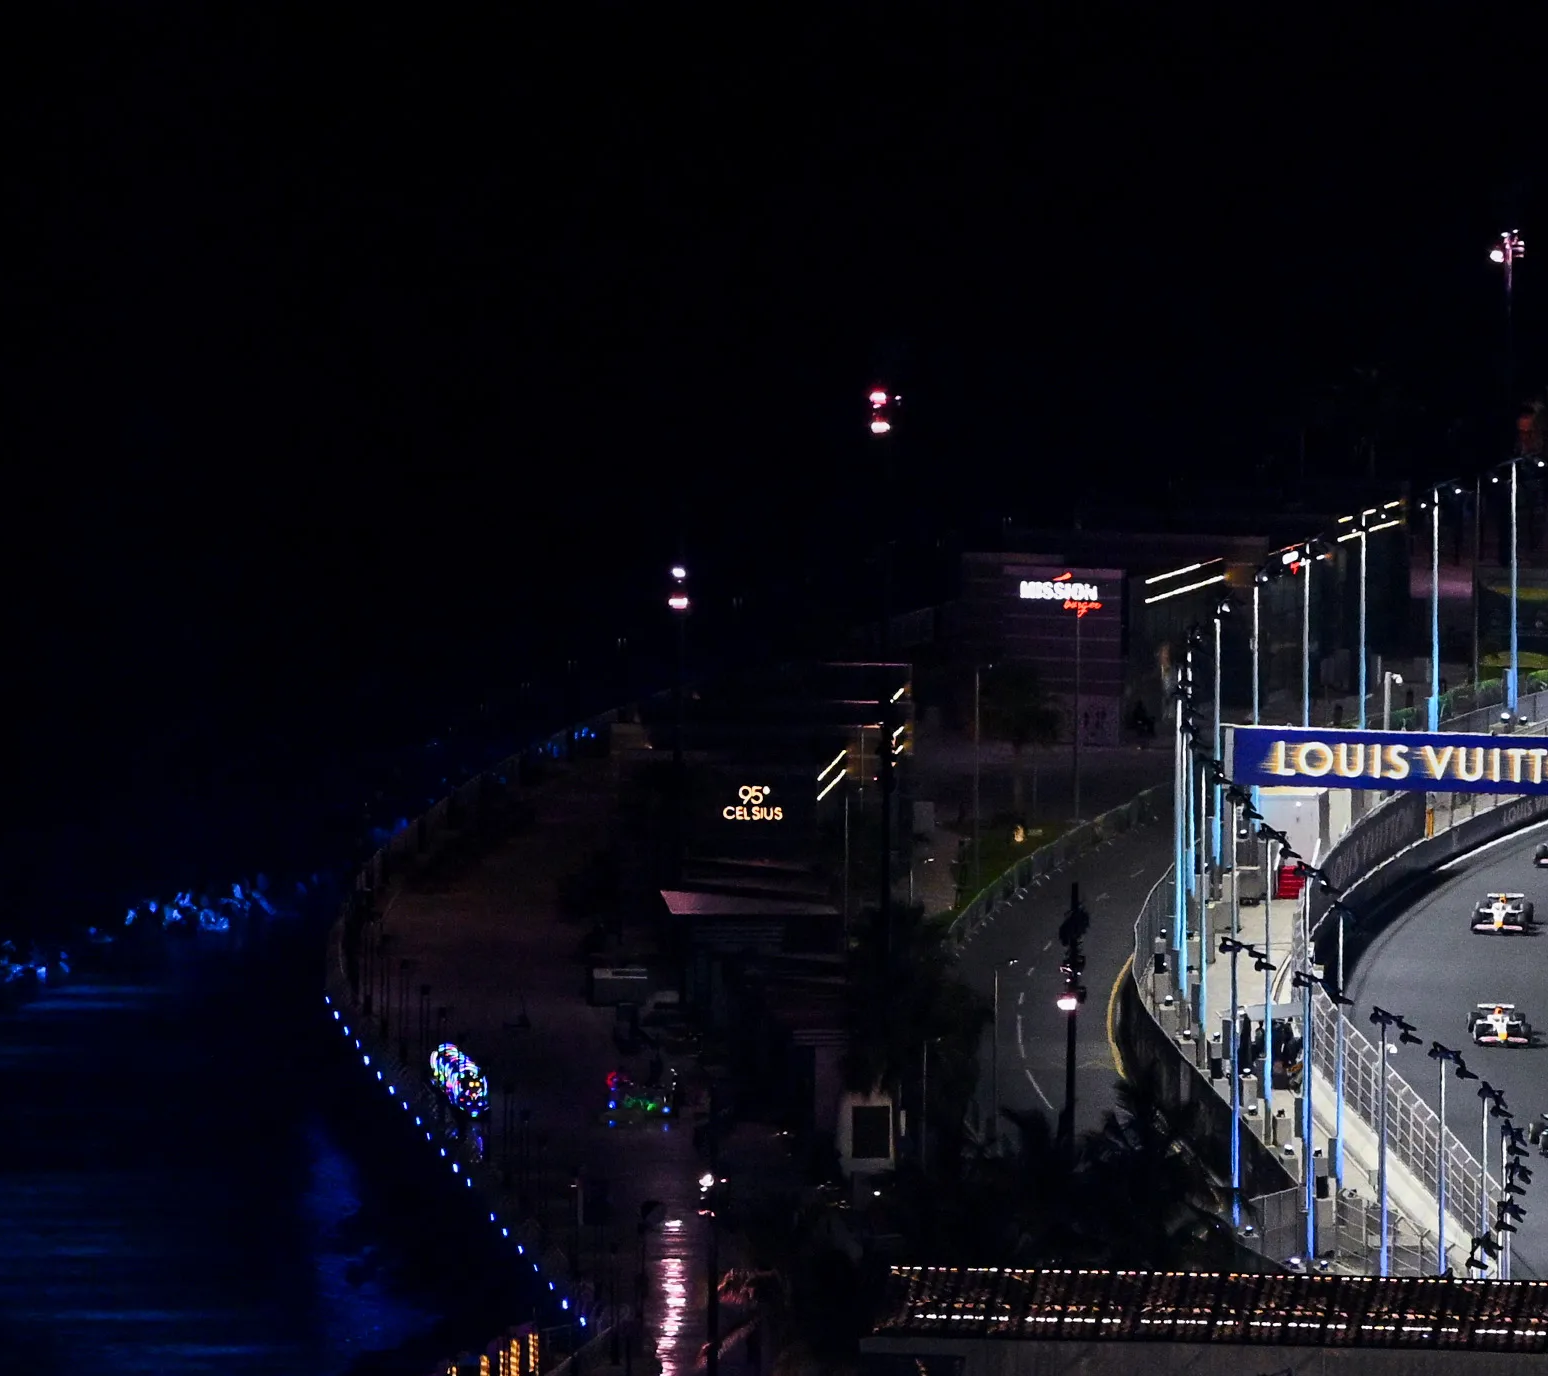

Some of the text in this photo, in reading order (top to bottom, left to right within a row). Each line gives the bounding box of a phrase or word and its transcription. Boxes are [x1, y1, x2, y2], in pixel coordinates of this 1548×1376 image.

[1020, 581, 1098, 601] MISSION
[1262, 739, 1411, 780] LOUIS
[722, 805, 783, 821] CELSIUS
